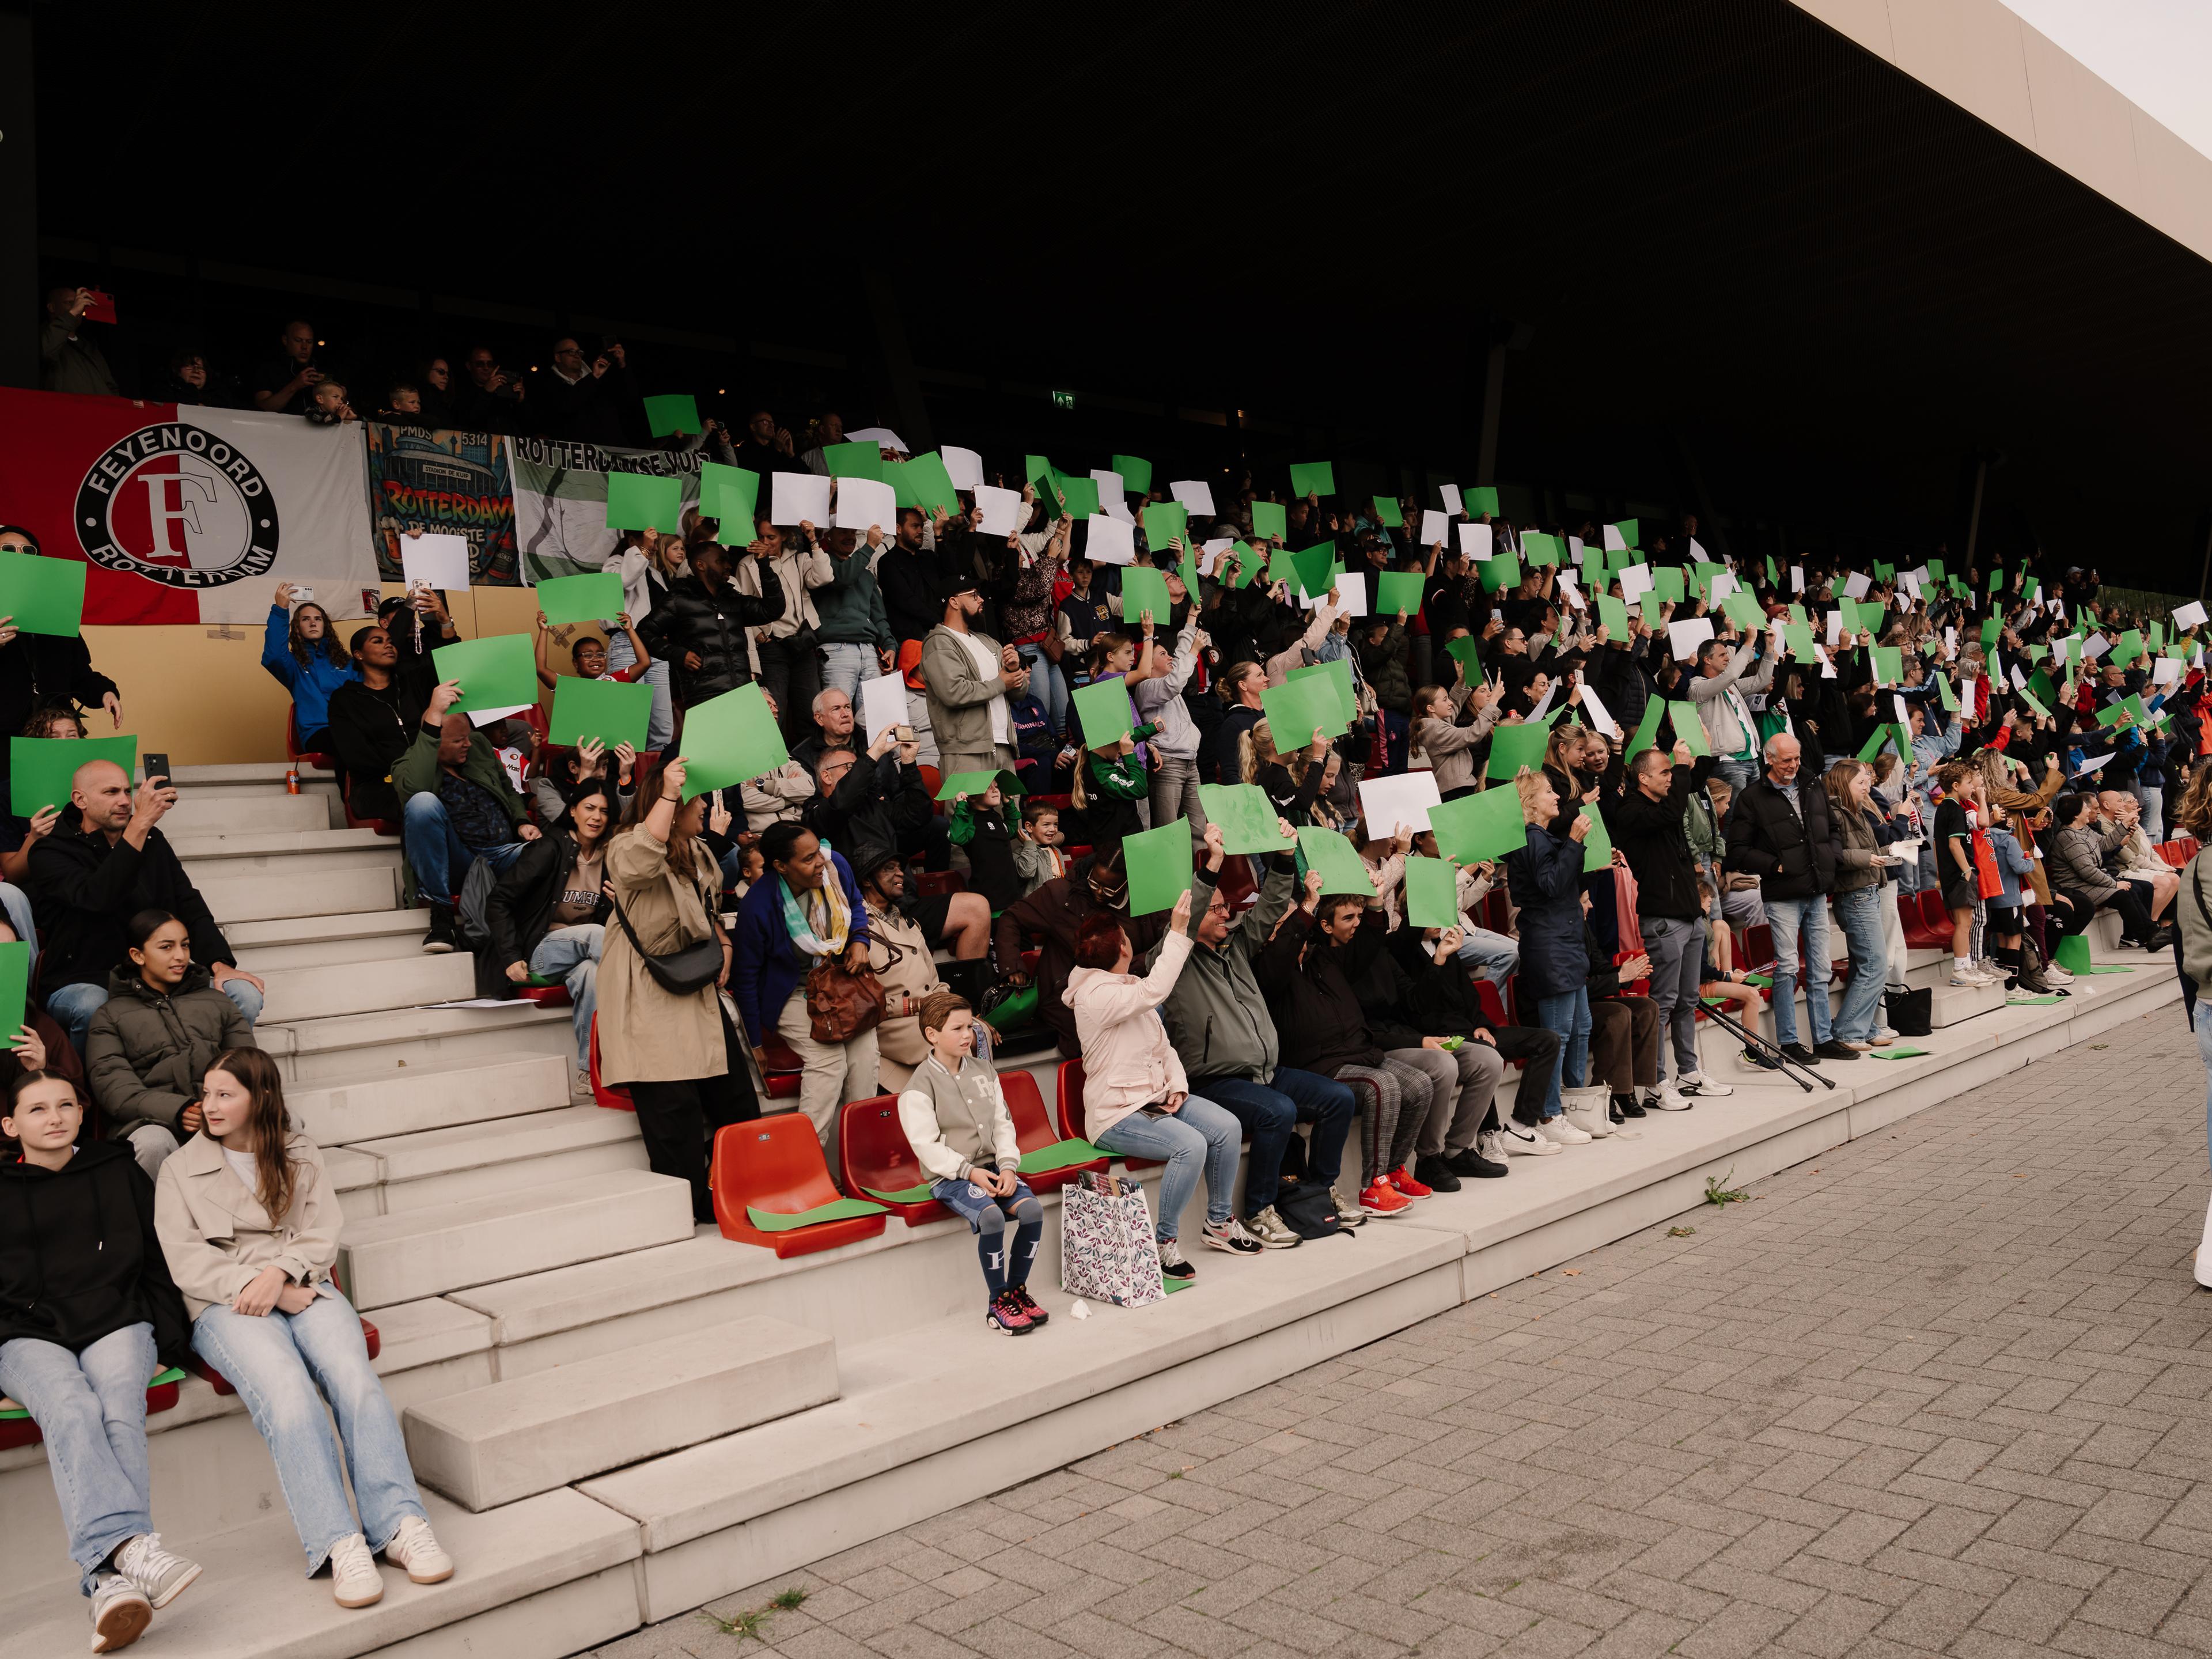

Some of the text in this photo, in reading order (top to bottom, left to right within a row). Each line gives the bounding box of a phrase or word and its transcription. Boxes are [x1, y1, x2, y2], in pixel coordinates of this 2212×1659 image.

[400, 426, 488, 446] PMDS 5314
[88, 427, 263, 497] FEYENOORD
[425, 466, 447, 475] STADION
[382, 479, 514, 527] ROTTERDAM
[92, 544, 274, 585] ROTTERDAM
